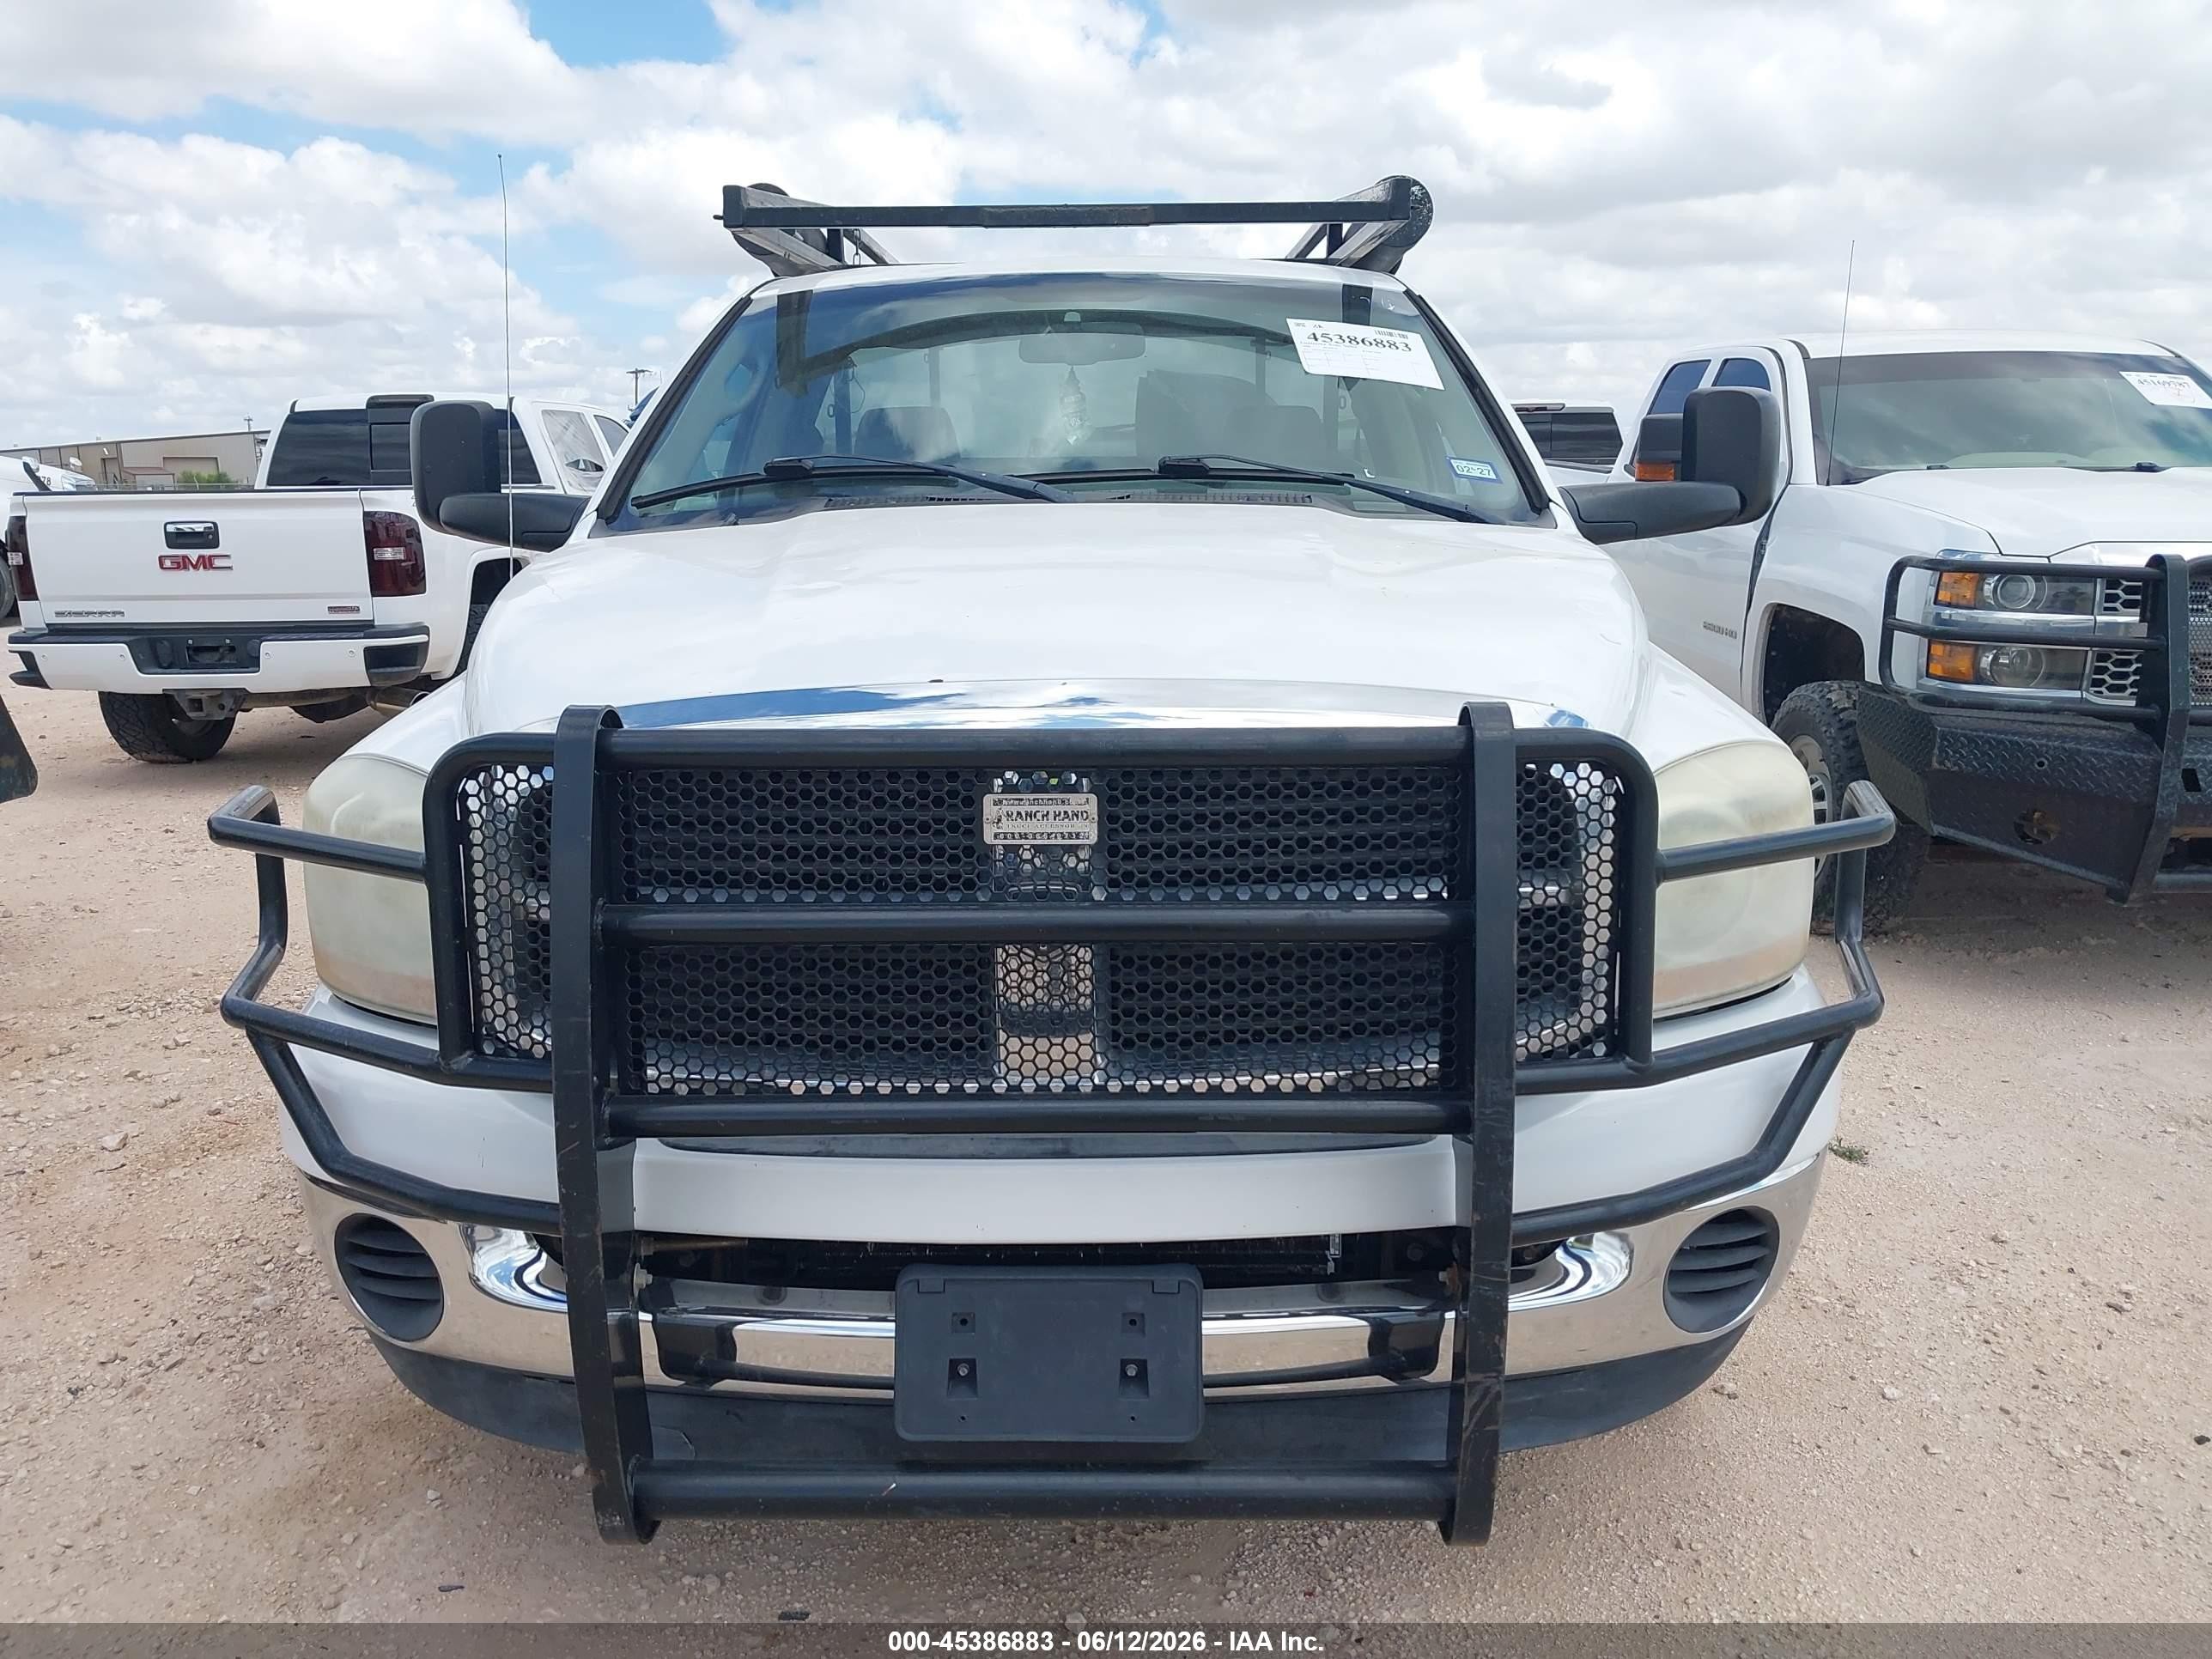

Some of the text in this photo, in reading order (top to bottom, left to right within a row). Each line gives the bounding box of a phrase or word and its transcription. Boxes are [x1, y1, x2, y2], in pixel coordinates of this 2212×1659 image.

[1307, 331, 1412, 352] 45386883
[1455, 465, 1491, 476] 02-27
[158, 554, 233, 571] GMC
[1006, 810, 1089, 822] RANCH HAND
